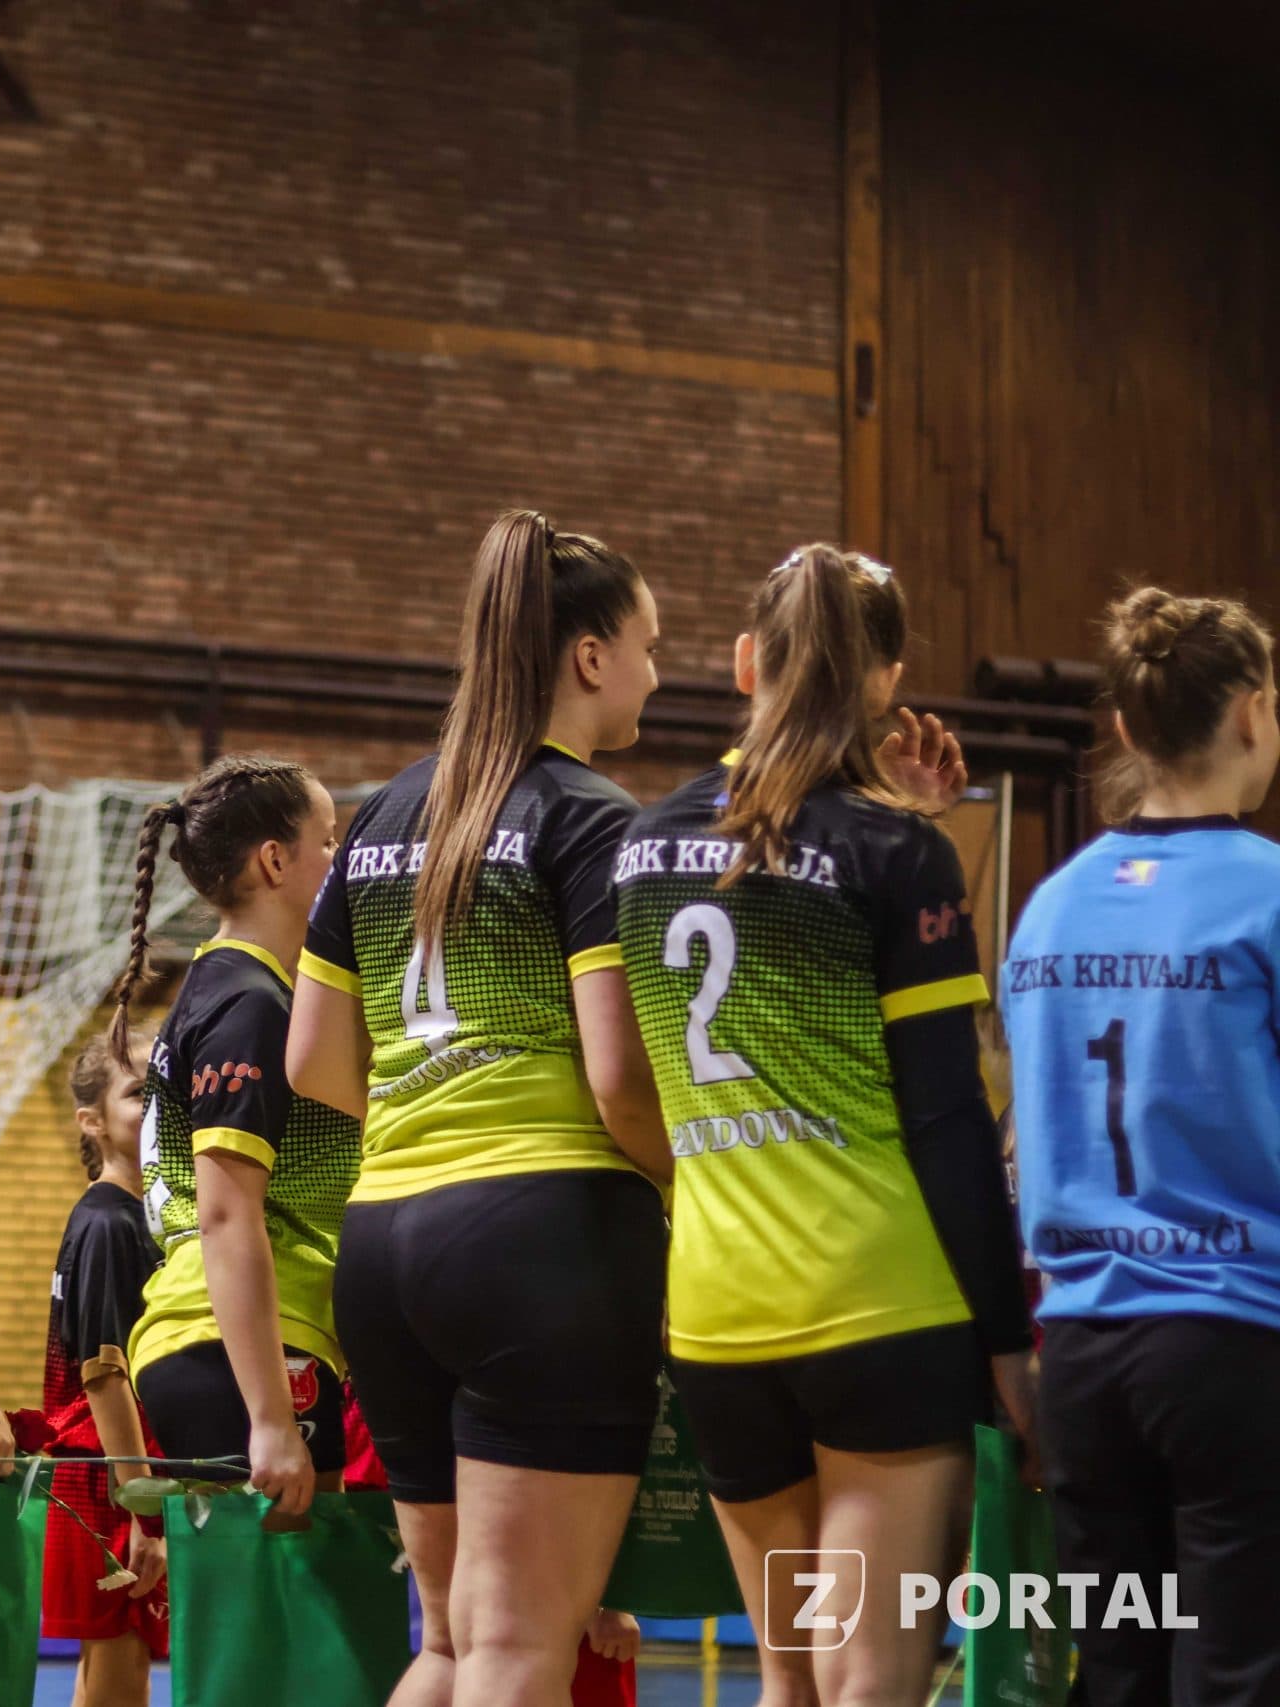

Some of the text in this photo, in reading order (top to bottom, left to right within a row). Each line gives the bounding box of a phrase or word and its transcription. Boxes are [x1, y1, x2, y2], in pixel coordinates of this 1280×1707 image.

[346, 837, 404, 881] ŽRK
[614, 838, 668, 884] ŽRK
[663, 904, 756, 1086] 2
[1073, 952, 1228, 992] KRIVAJA
[1087, 1018, 1137, 1197] 1
